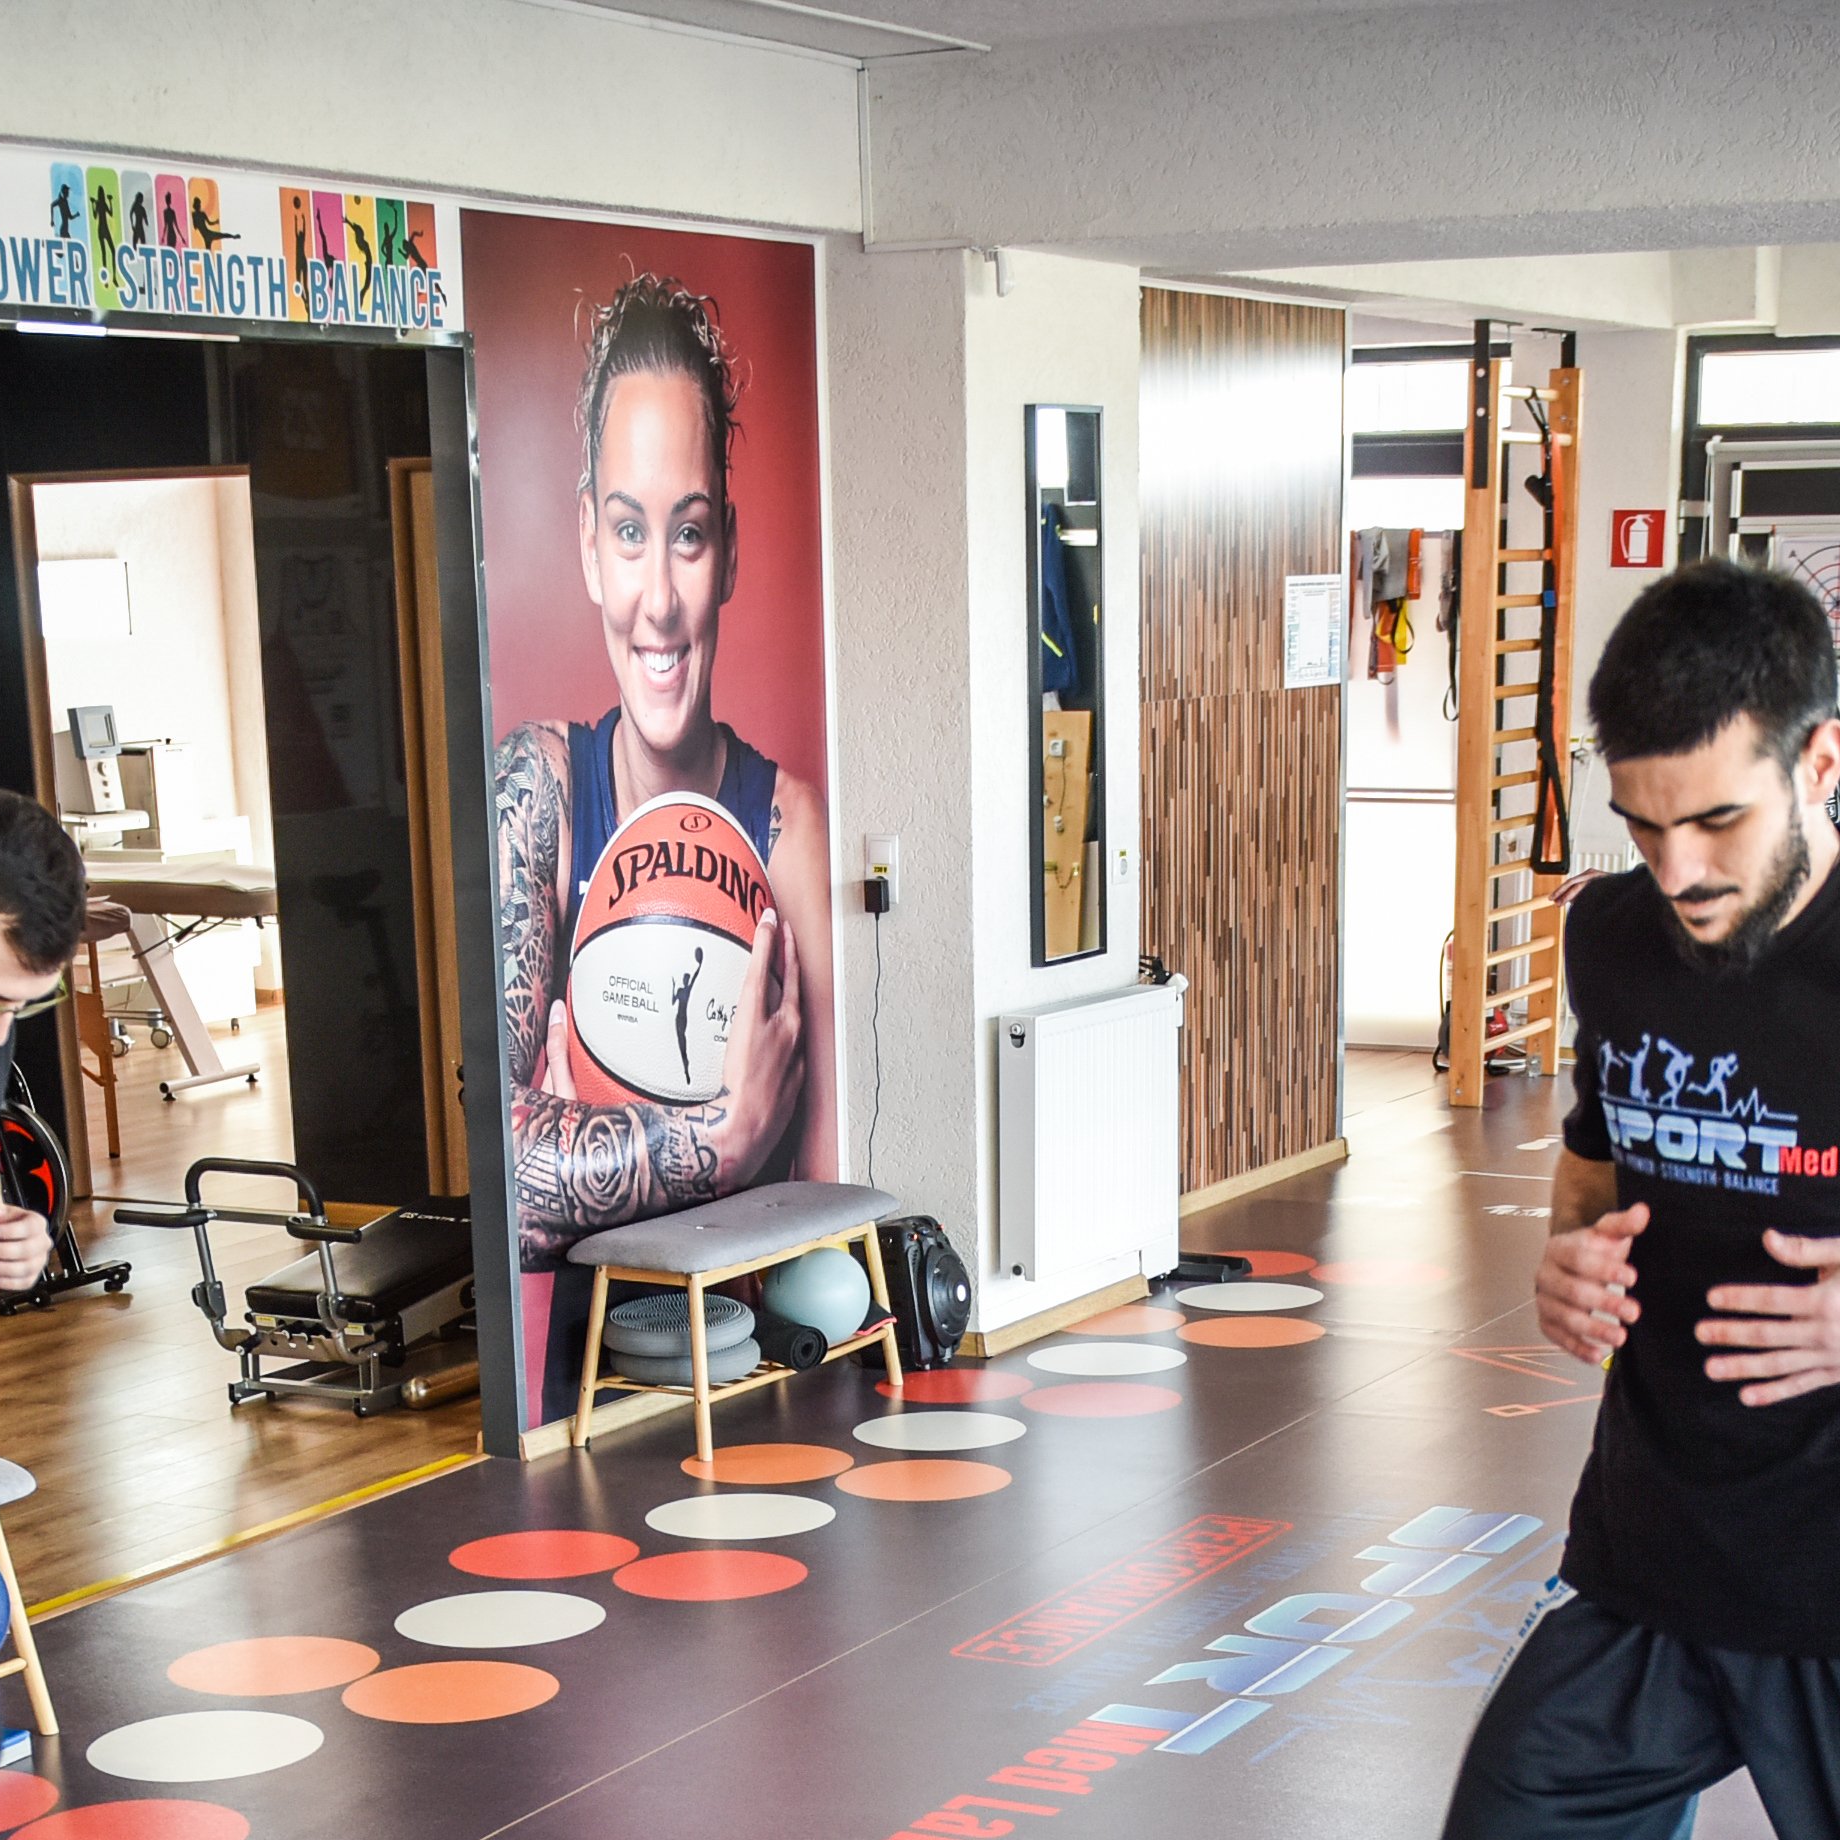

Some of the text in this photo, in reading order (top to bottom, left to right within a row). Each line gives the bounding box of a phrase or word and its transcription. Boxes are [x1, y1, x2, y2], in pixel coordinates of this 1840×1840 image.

[117, 246, 287, 319] STRENGTH
[309, 259, 444, 329] BALANCE
[1789, 550, 1797, 558] A
[609, 841, 769, 928] SPALDING
[602, 990, 659, 1013] GAME BALL
[609, 976, 654, 995] OFFICIAL
[1779, 1146, 1838, 1177] Med
[976, 1518, 1276, 1661] PERFORMANCE
[1087, 1506, 1544, 1755] SPORT
[987, 1719, 1173, 1795] Med
